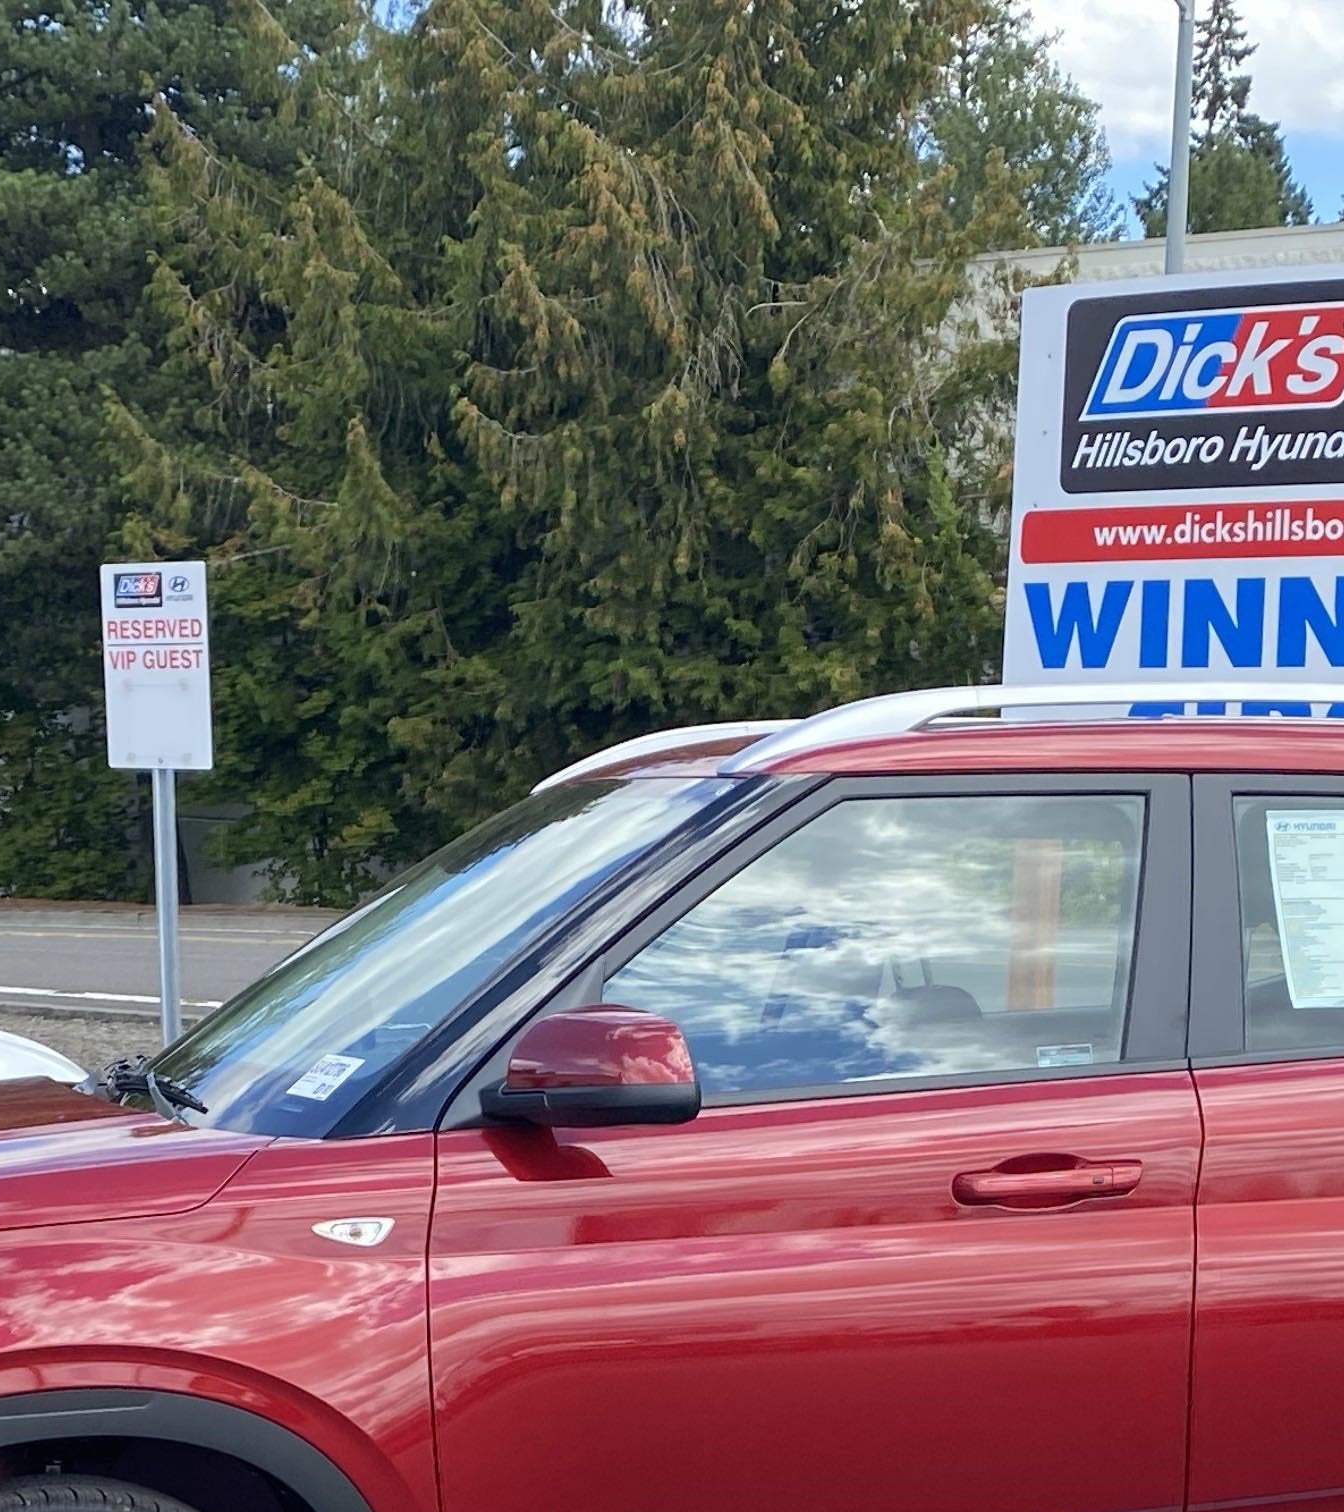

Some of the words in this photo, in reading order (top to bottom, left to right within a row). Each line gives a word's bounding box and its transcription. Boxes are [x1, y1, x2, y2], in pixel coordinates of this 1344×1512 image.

[1072, 430, 1225, 469] Hillsboro
[108, 619, 202, 639] RESERVED
[109, 651, 136, 669] VIP
[143, 650, 203, 669] GUEST
